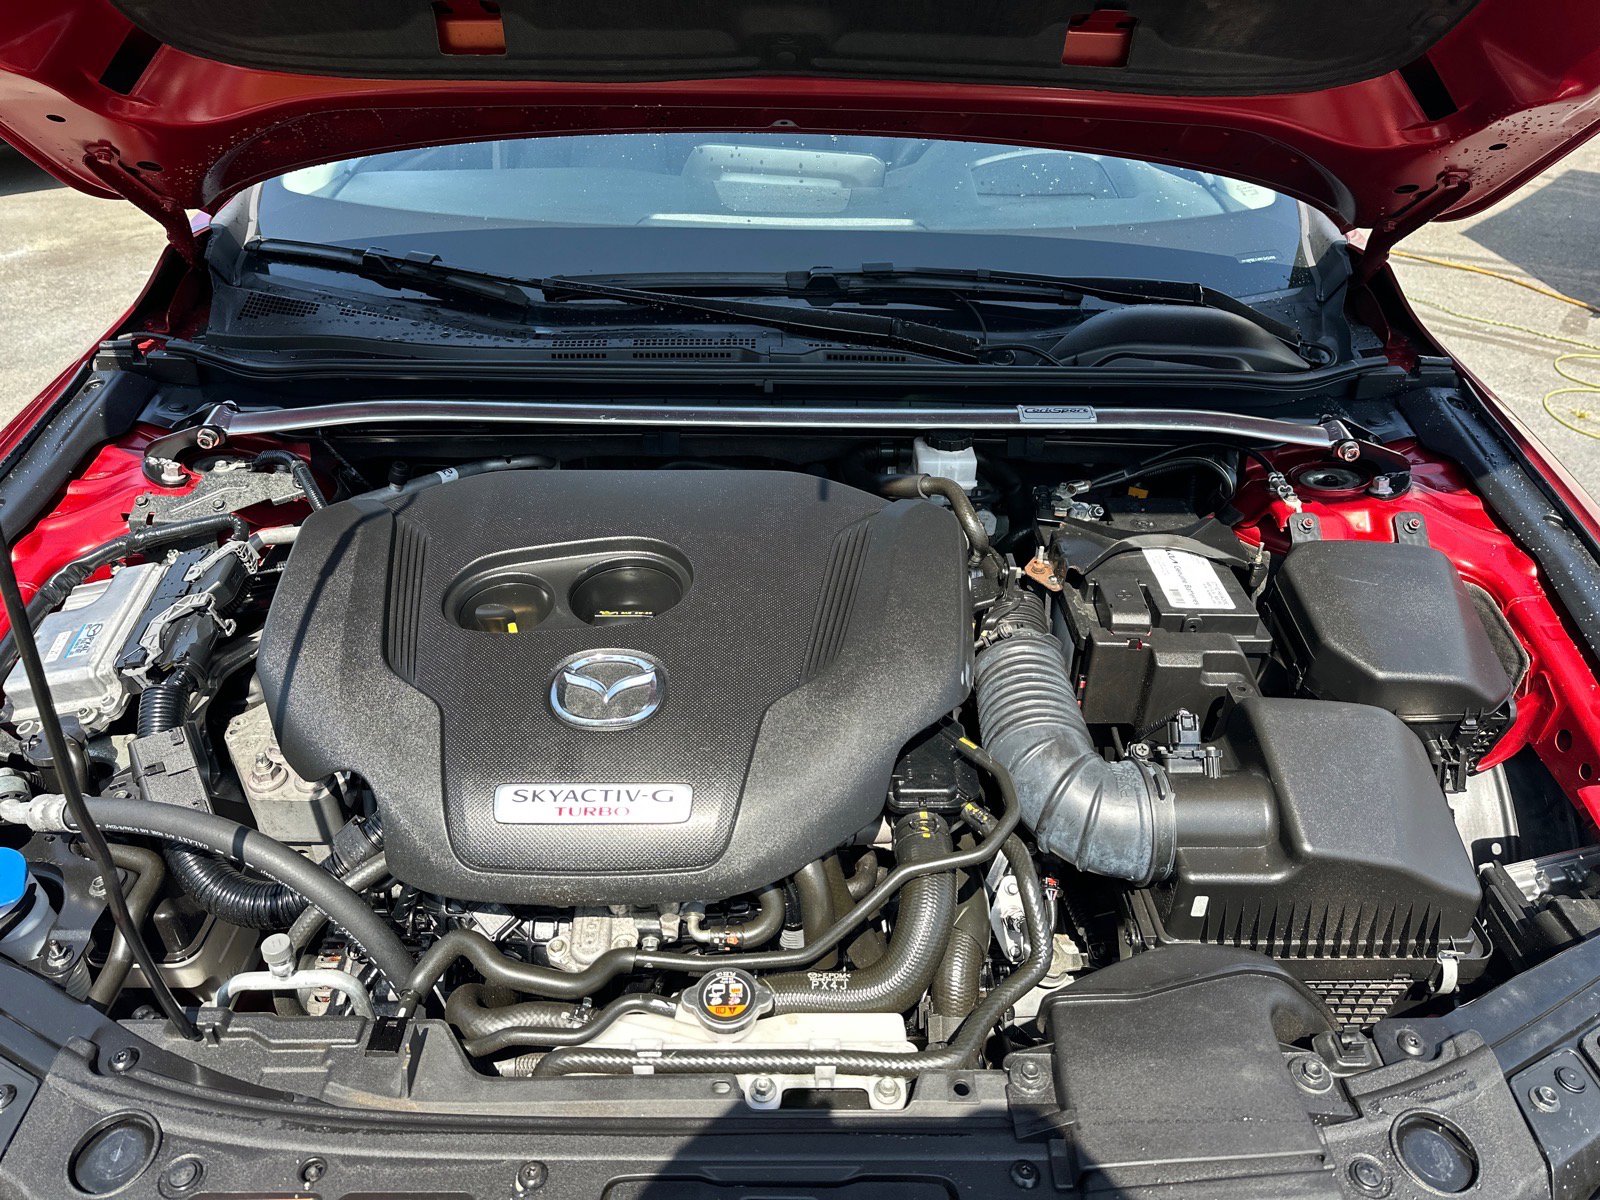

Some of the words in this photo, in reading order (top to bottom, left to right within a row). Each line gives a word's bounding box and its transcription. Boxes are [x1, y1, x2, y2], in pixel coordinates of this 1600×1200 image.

[512, 789, 674, 803] SKYACTIV-G
[554, 806, 630, 817] TURBO
[178, 836, 209, 850] GALAXY
[811, 980, 848, 990] PX4J
